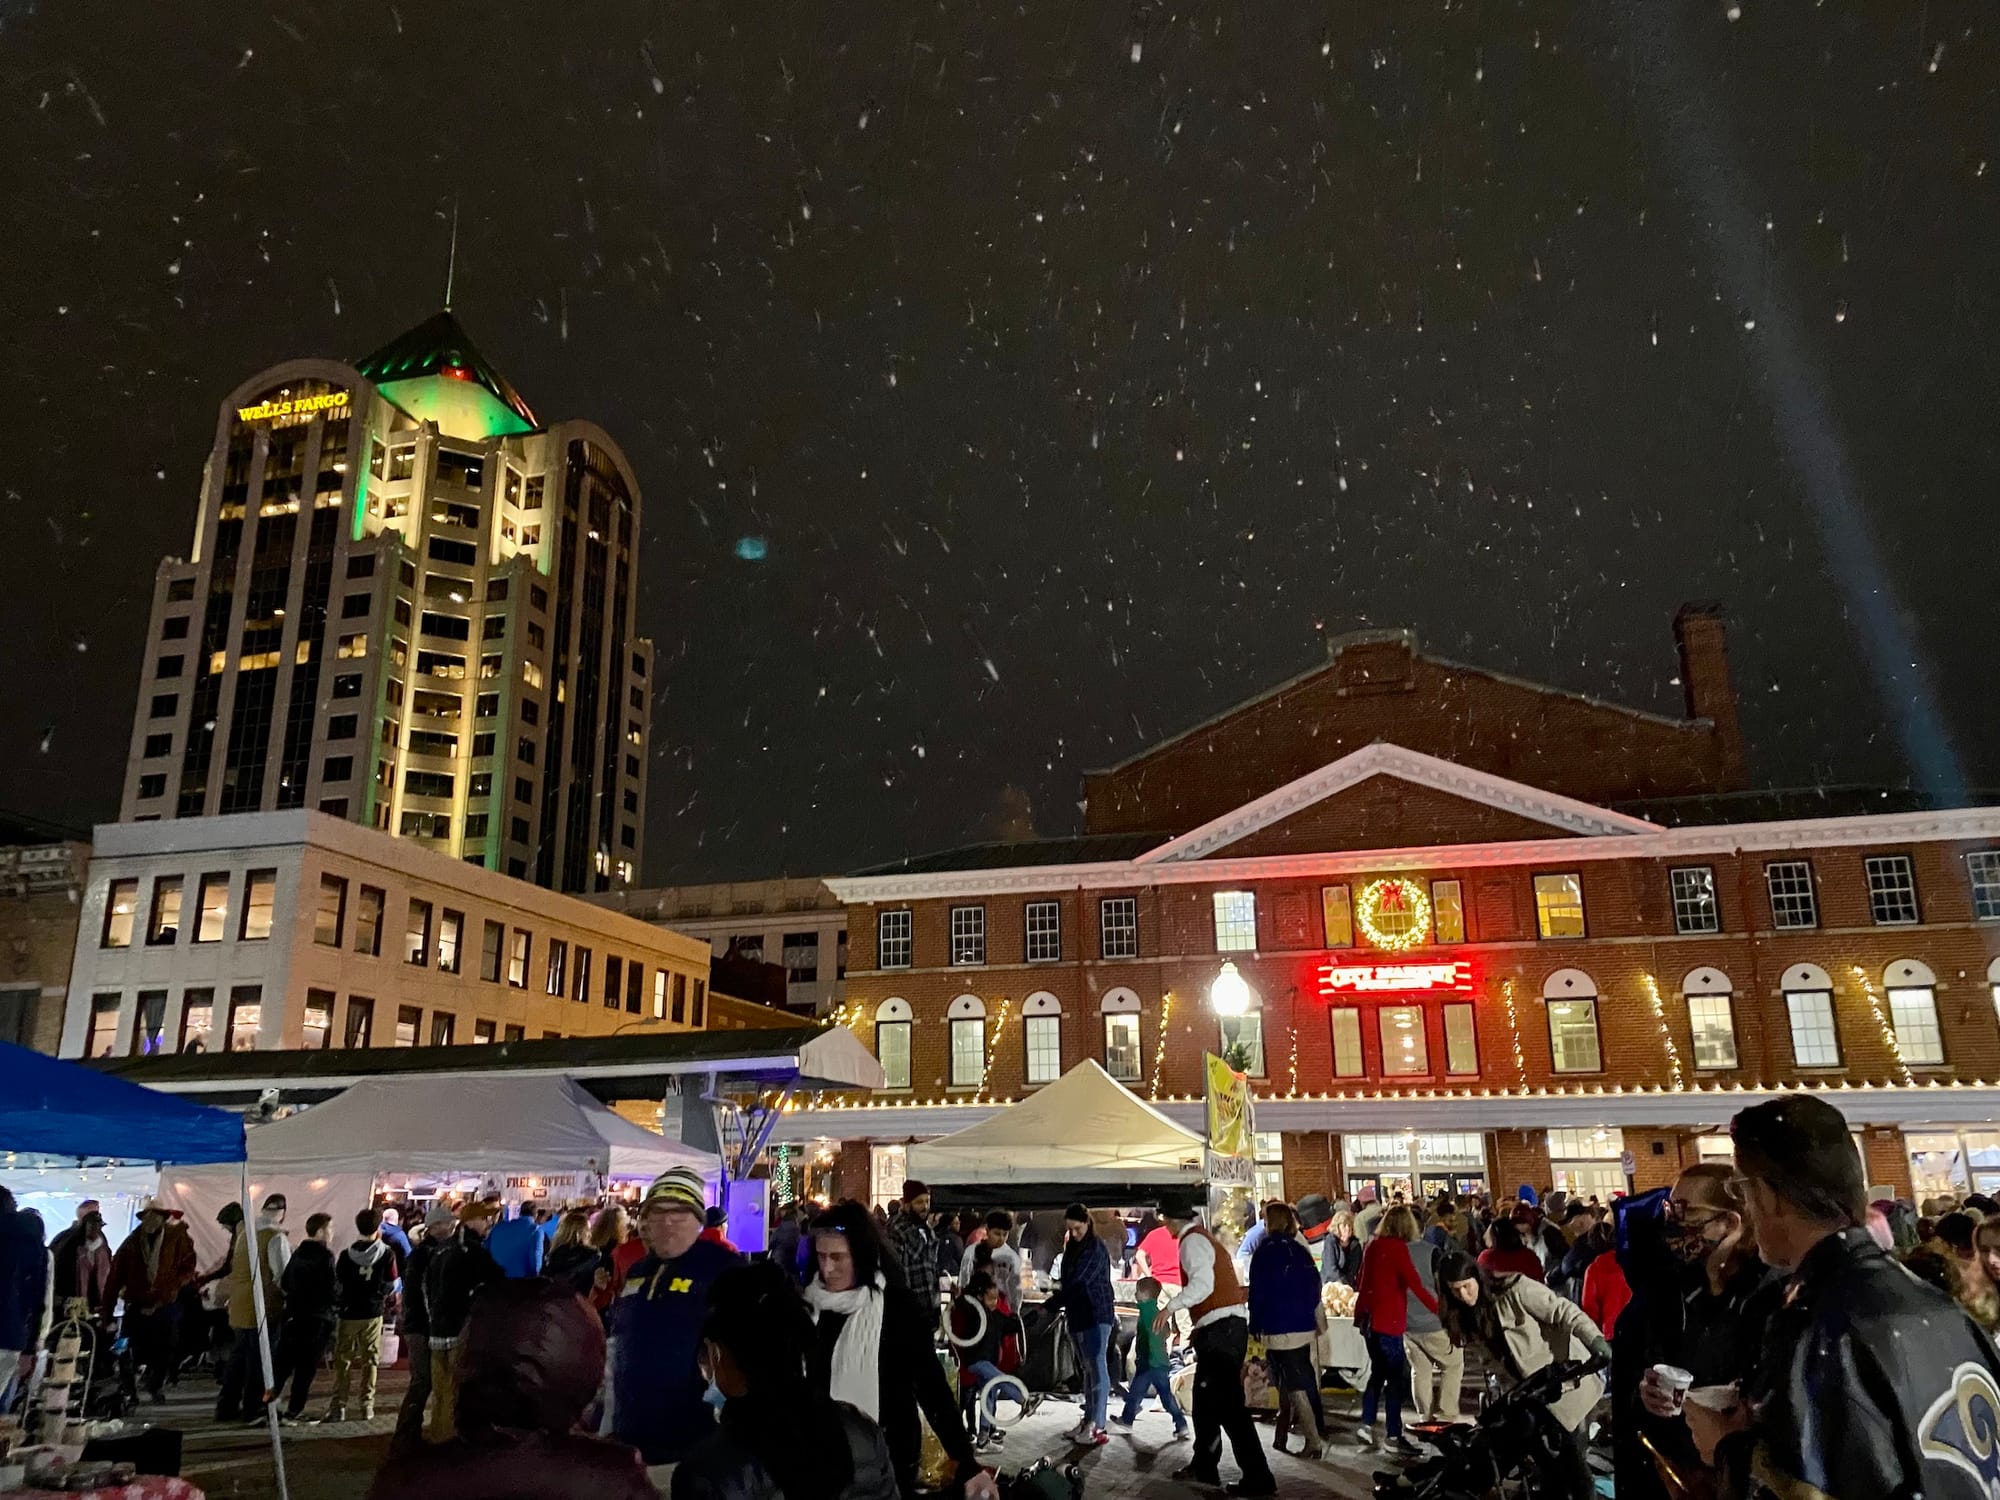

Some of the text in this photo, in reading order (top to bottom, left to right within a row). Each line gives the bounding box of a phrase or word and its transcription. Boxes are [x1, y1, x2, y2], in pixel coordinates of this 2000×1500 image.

[239, 392, 348, 421] WELLS FARGO
[1397, 1141, 1428, 1150] 32
